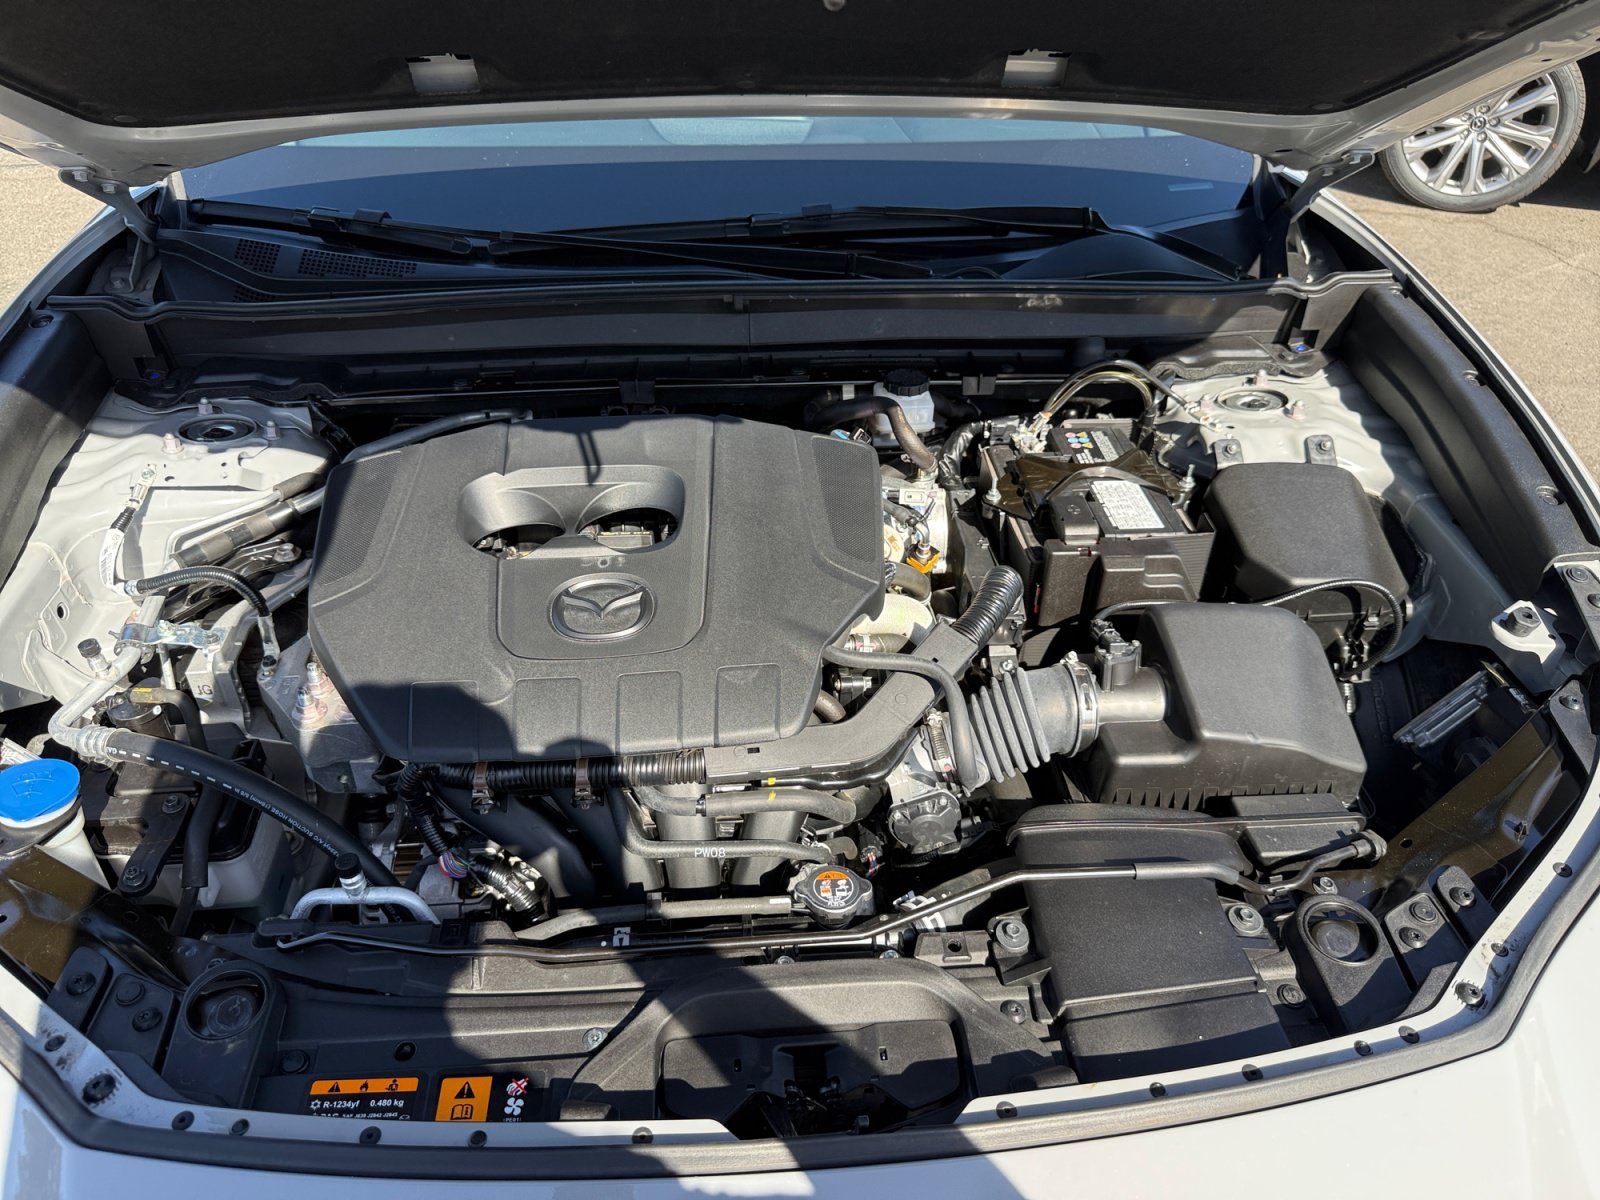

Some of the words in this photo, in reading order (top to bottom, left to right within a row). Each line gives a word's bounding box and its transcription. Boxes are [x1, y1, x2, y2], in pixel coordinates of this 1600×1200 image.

[271, 807, 288, 820] HOSE
[288, 818, 314, 837] SUCTION
[694, 847, 726, 858] PW08
[323, 1099, 360, 1109] R-1234yf
[370, 1099, 392, 1107] 0.480
[393, 1098, 404, 1108] kg
